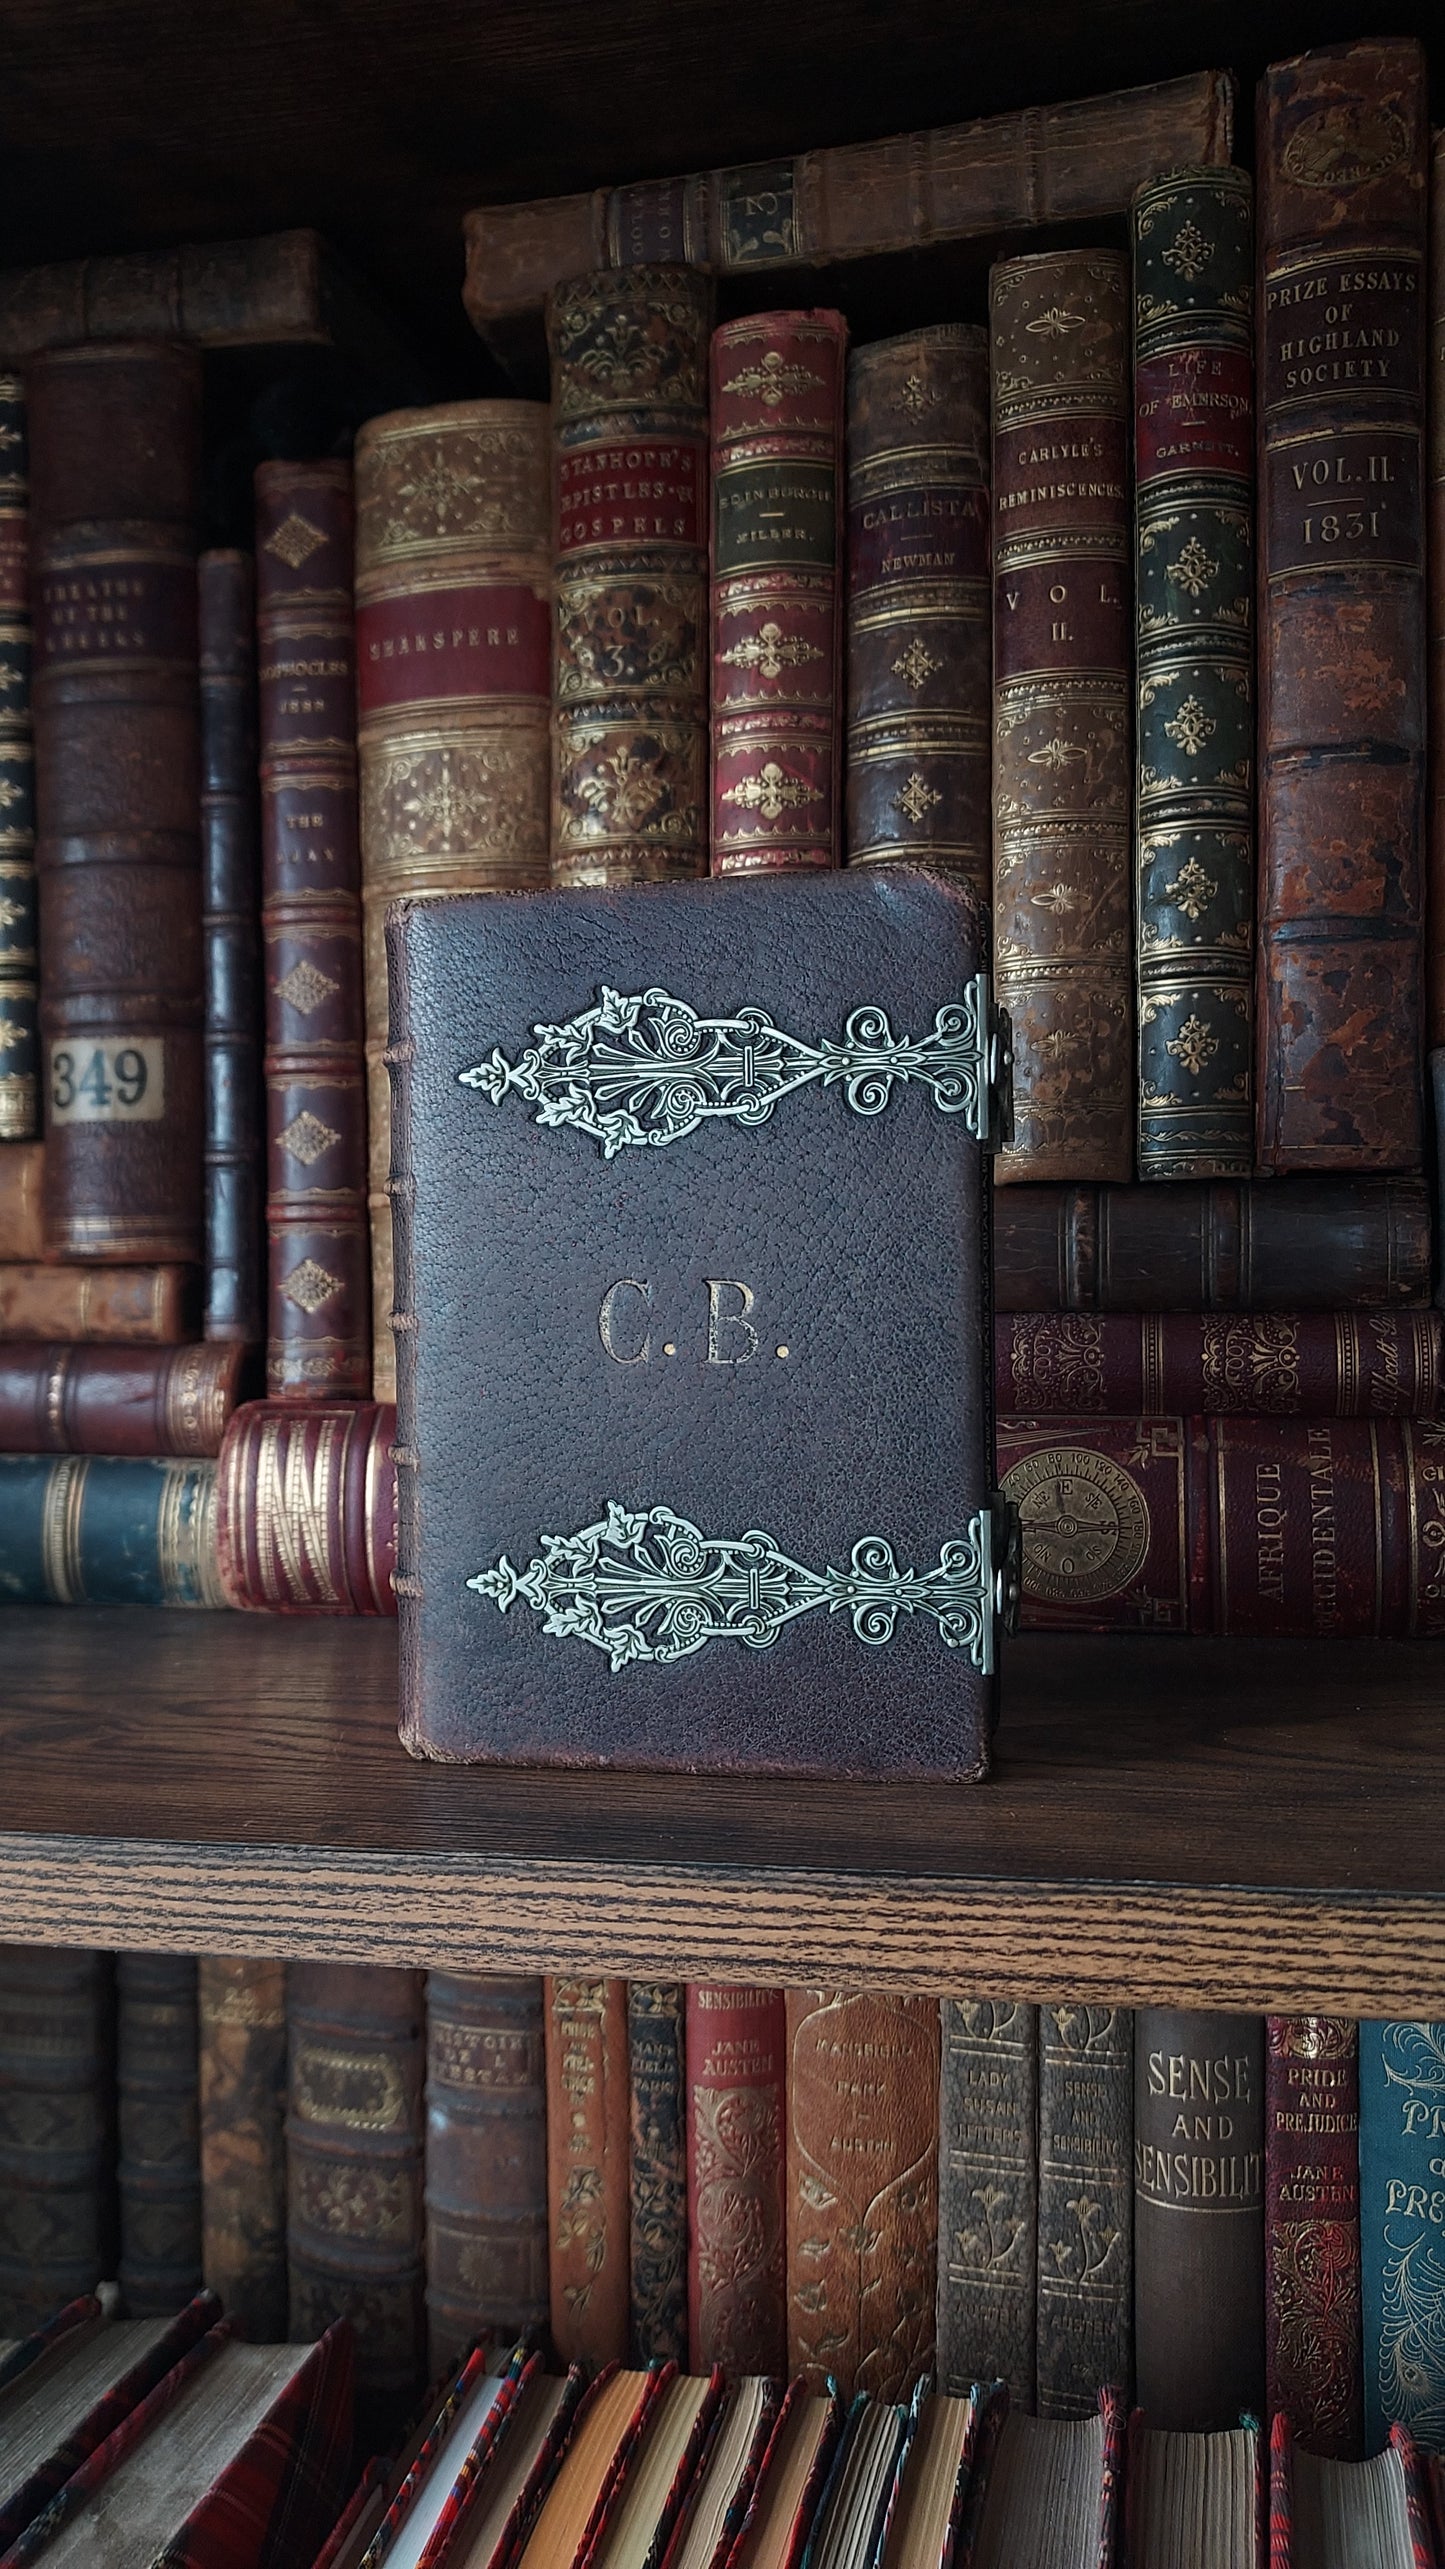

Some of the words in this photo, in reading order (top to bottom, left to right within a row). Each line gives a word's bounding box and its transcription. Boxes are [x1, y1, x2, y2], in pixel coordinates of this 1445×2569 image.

[1266, 276, 1328, 311] PRIZE
[1338, 271, 1416, 293] ESSAYS
[1325, 303, 1353, 324] OF
[1280, 329, 1400, 362] HIGHLAND
[1168, 360, 1222, 378] LIFE
[1285, 359, 1391, 389] SOCIETY
[1139, 400, 1160, 418] OF
[1018, 437, 1104, 466] CARLYLE'S
[559, 449, 693, 481] STANHOPE'S
[999, 482, 1125, 512] REMINISCENCES.
[863, 500, 976, 530] CALLISTA
[560, 517, 686, 545] GOSPELS
[1303, 511, 1379, 545] 1831
[880, 552, 956, 575] NEWMAN
[584, 605, 662, 630] VOL.
[1051, 622, 1075, 642] II.
[601, 644, 636, 678] 3.
[53, 1049, 148, 1110] 349
[599, 1278, 676, 1365] C.
[701, 1278, 790, 1365] B.
[1047, 1453, 1063, 1464] 80
[1071, 1453, 1090, 1465] 100
[1095, 1460, 1113, 1475] 120
[1061, 1479, 1074, 1496] E
[1113, 1473, 1129, 1491] 140
[1127, 1496, 1141, 1514] 160
[1133, 1520, 1144, 1539] 180
[1255, 1462, 1288, 1604] AFRIQUE
[698, 1988, 777, 2010] SENSIBILITY
[711, 2038, 760, 2056] JANE
[702, 2055, 774, 2077] AUSTEN
[968, 2070, 1009, 2087] LADY
[1147, 2050, 1251, 2105] SENSE
[1287, 2068, 1346, 2088] PRIDE
[1065, 2081, 1108, 2098] SENSE
[963, 2097, 1017, 2117] SUSAN
[1299, 2093, 1336, 2110] AND
[1071, 2110, 1098, 2126] AND
[1171, 2112, 1234, 2141] AND
[1276, 2111, 1358, 2134] PREJUDICE
[958, 2123, 1023, 2144] LETTERS
[1053, 2134, 1118, 2154] SENSIBILITY
[1291, 2164, 1344, 2182] JANE
[1279, 2184, 1355, 2202] AUSTEN
